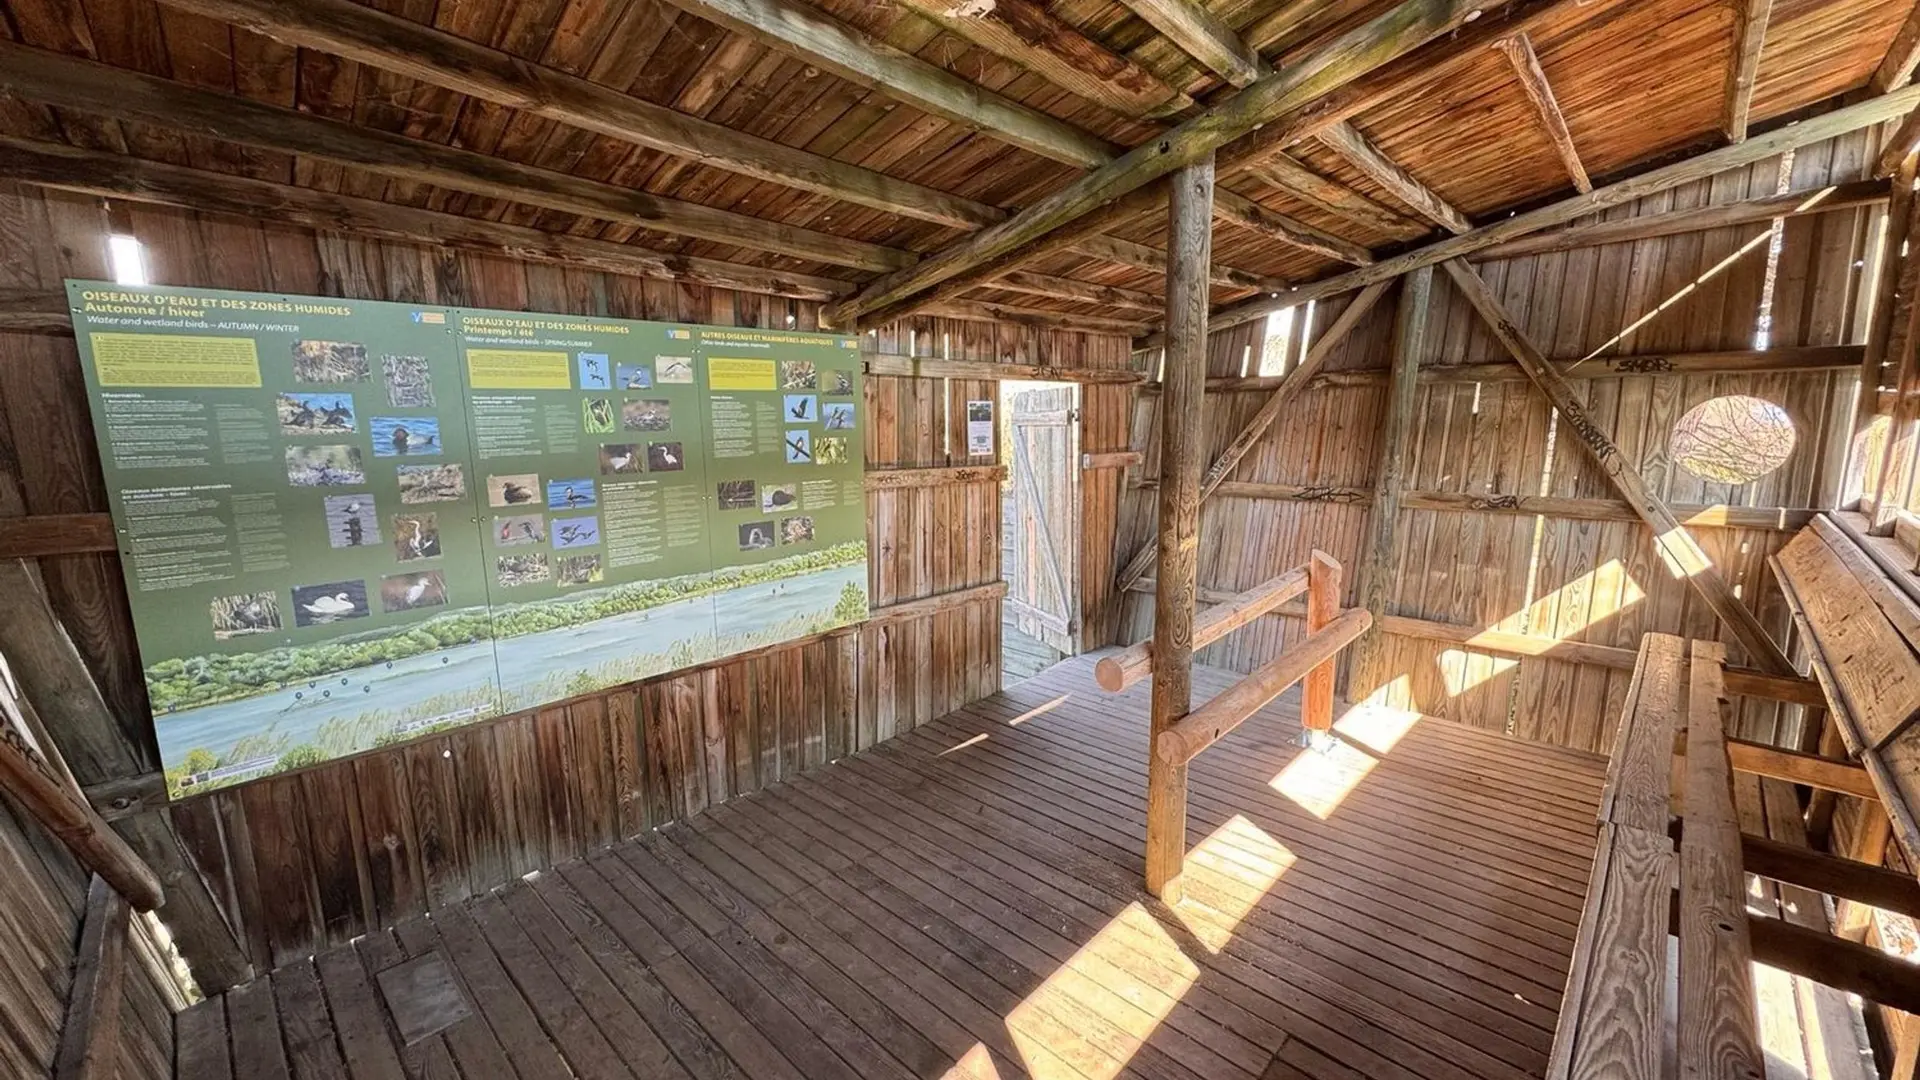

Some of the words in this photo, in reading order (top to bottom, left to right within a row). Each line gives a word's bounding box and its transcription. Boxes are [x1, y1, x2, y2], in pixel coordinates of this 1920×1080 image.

[82, 290, 152, 305] OISEAUX
[154, 294, 198, 307] D'EAU
[201, 297, 217, 308] ET
[221, 298, 247, 310] DES
[249, 300, 292, 313] ZONES
[295, 304, 352, 316] HUMIDES
[85, 301, 157, 316] Automne
[159, 305, 165, 316] /
[168, 305, 206, 318] hiver
[87, 314, 121, 325] Water
[120, 317, 142, 326] and
[143, 318, 184, 329] wetland
[185, 320, 208, 330] birds
[463, 316, 504, 326] OISEAUX
[535, 321, 545, 329] ET
[547, 321, 564, 330] DES
[565, 323, 593, 332] ZONES
[594, 325, 630, 334] HUMIDES
[463, 325, 512, 336] Printemps
